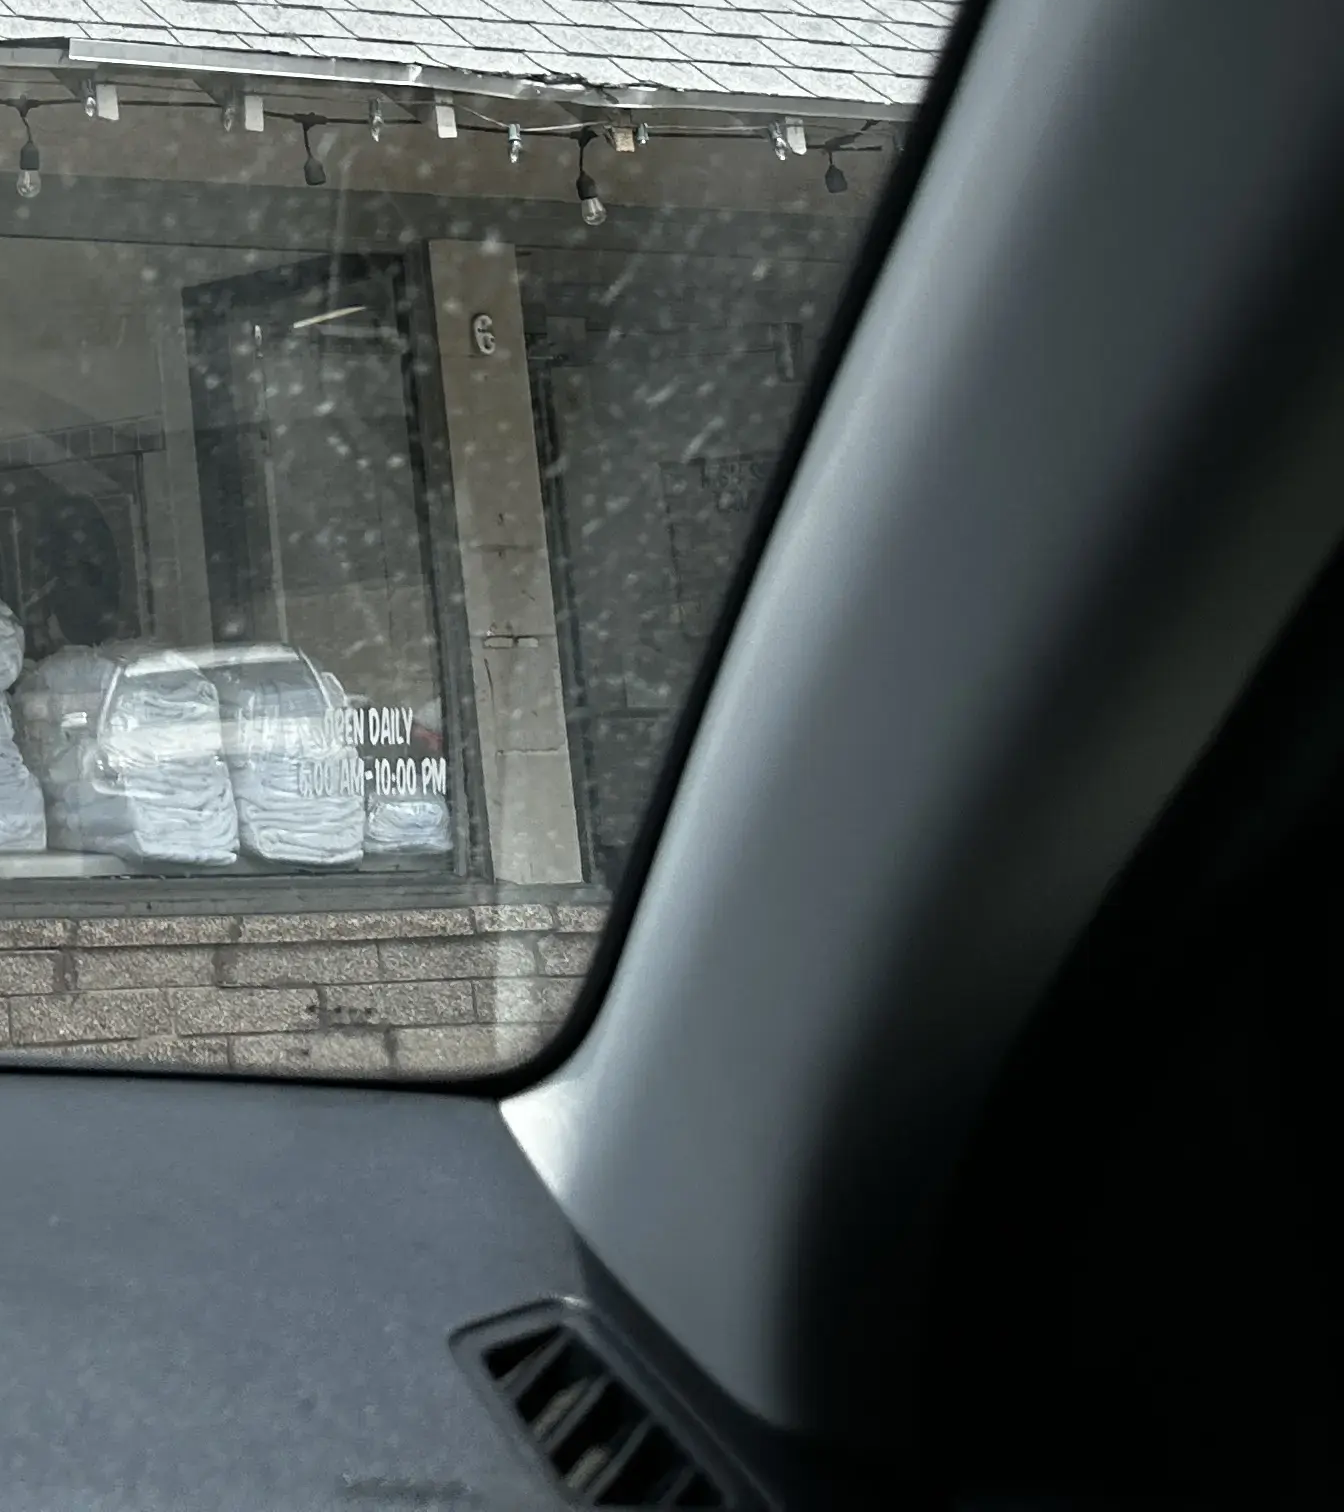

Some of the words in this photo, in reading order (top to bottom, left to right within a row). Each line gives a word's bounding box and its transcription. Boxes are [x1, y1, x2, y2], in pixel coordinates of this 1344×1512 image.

[473, 314, 496, 355] 6
[324, 707, 364, 745] OPEN
[368, 707, 413, 745] DAILY
[422, 757, 447, 796] PM
